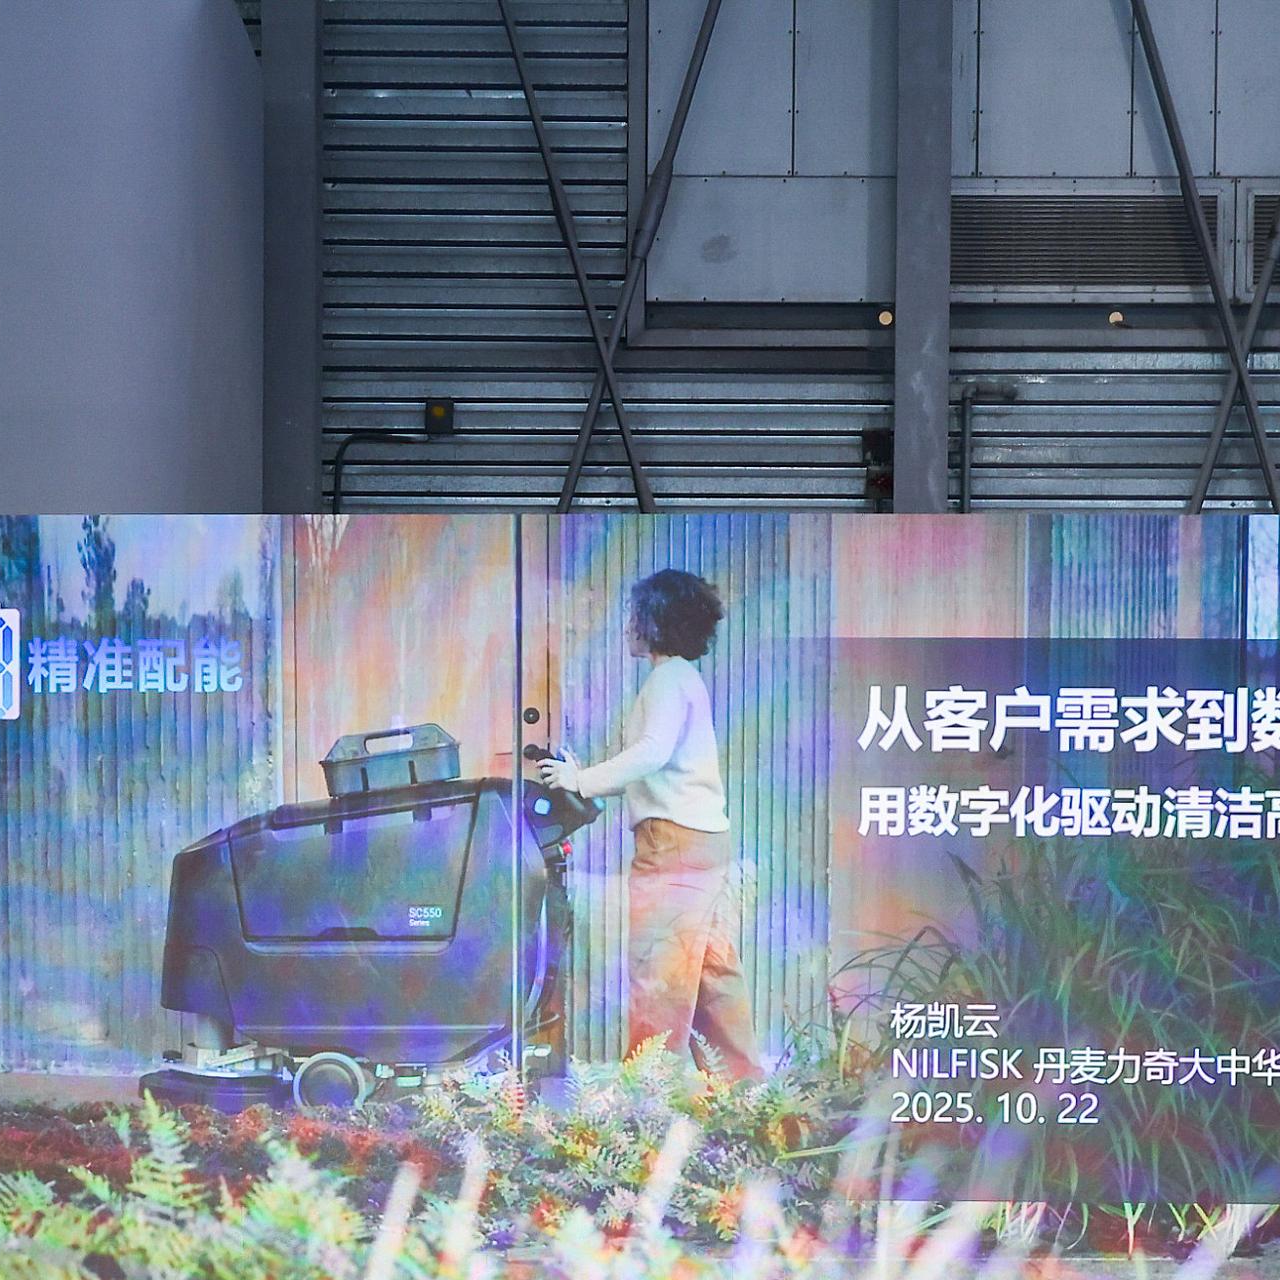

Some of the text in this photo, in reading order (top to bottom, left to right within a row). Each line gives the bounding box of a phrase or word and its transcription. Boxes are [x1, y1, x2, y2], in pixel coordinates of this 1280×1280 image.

[27, 636, 244, 694] 精准配能
[409, 907, 442, 918] SC550
[890, 1002, 1001, 1040] 杨凯云
[891, 1048, 1024, 1081] NILFISK
[1057, 1092, 1100, 1126] 22
